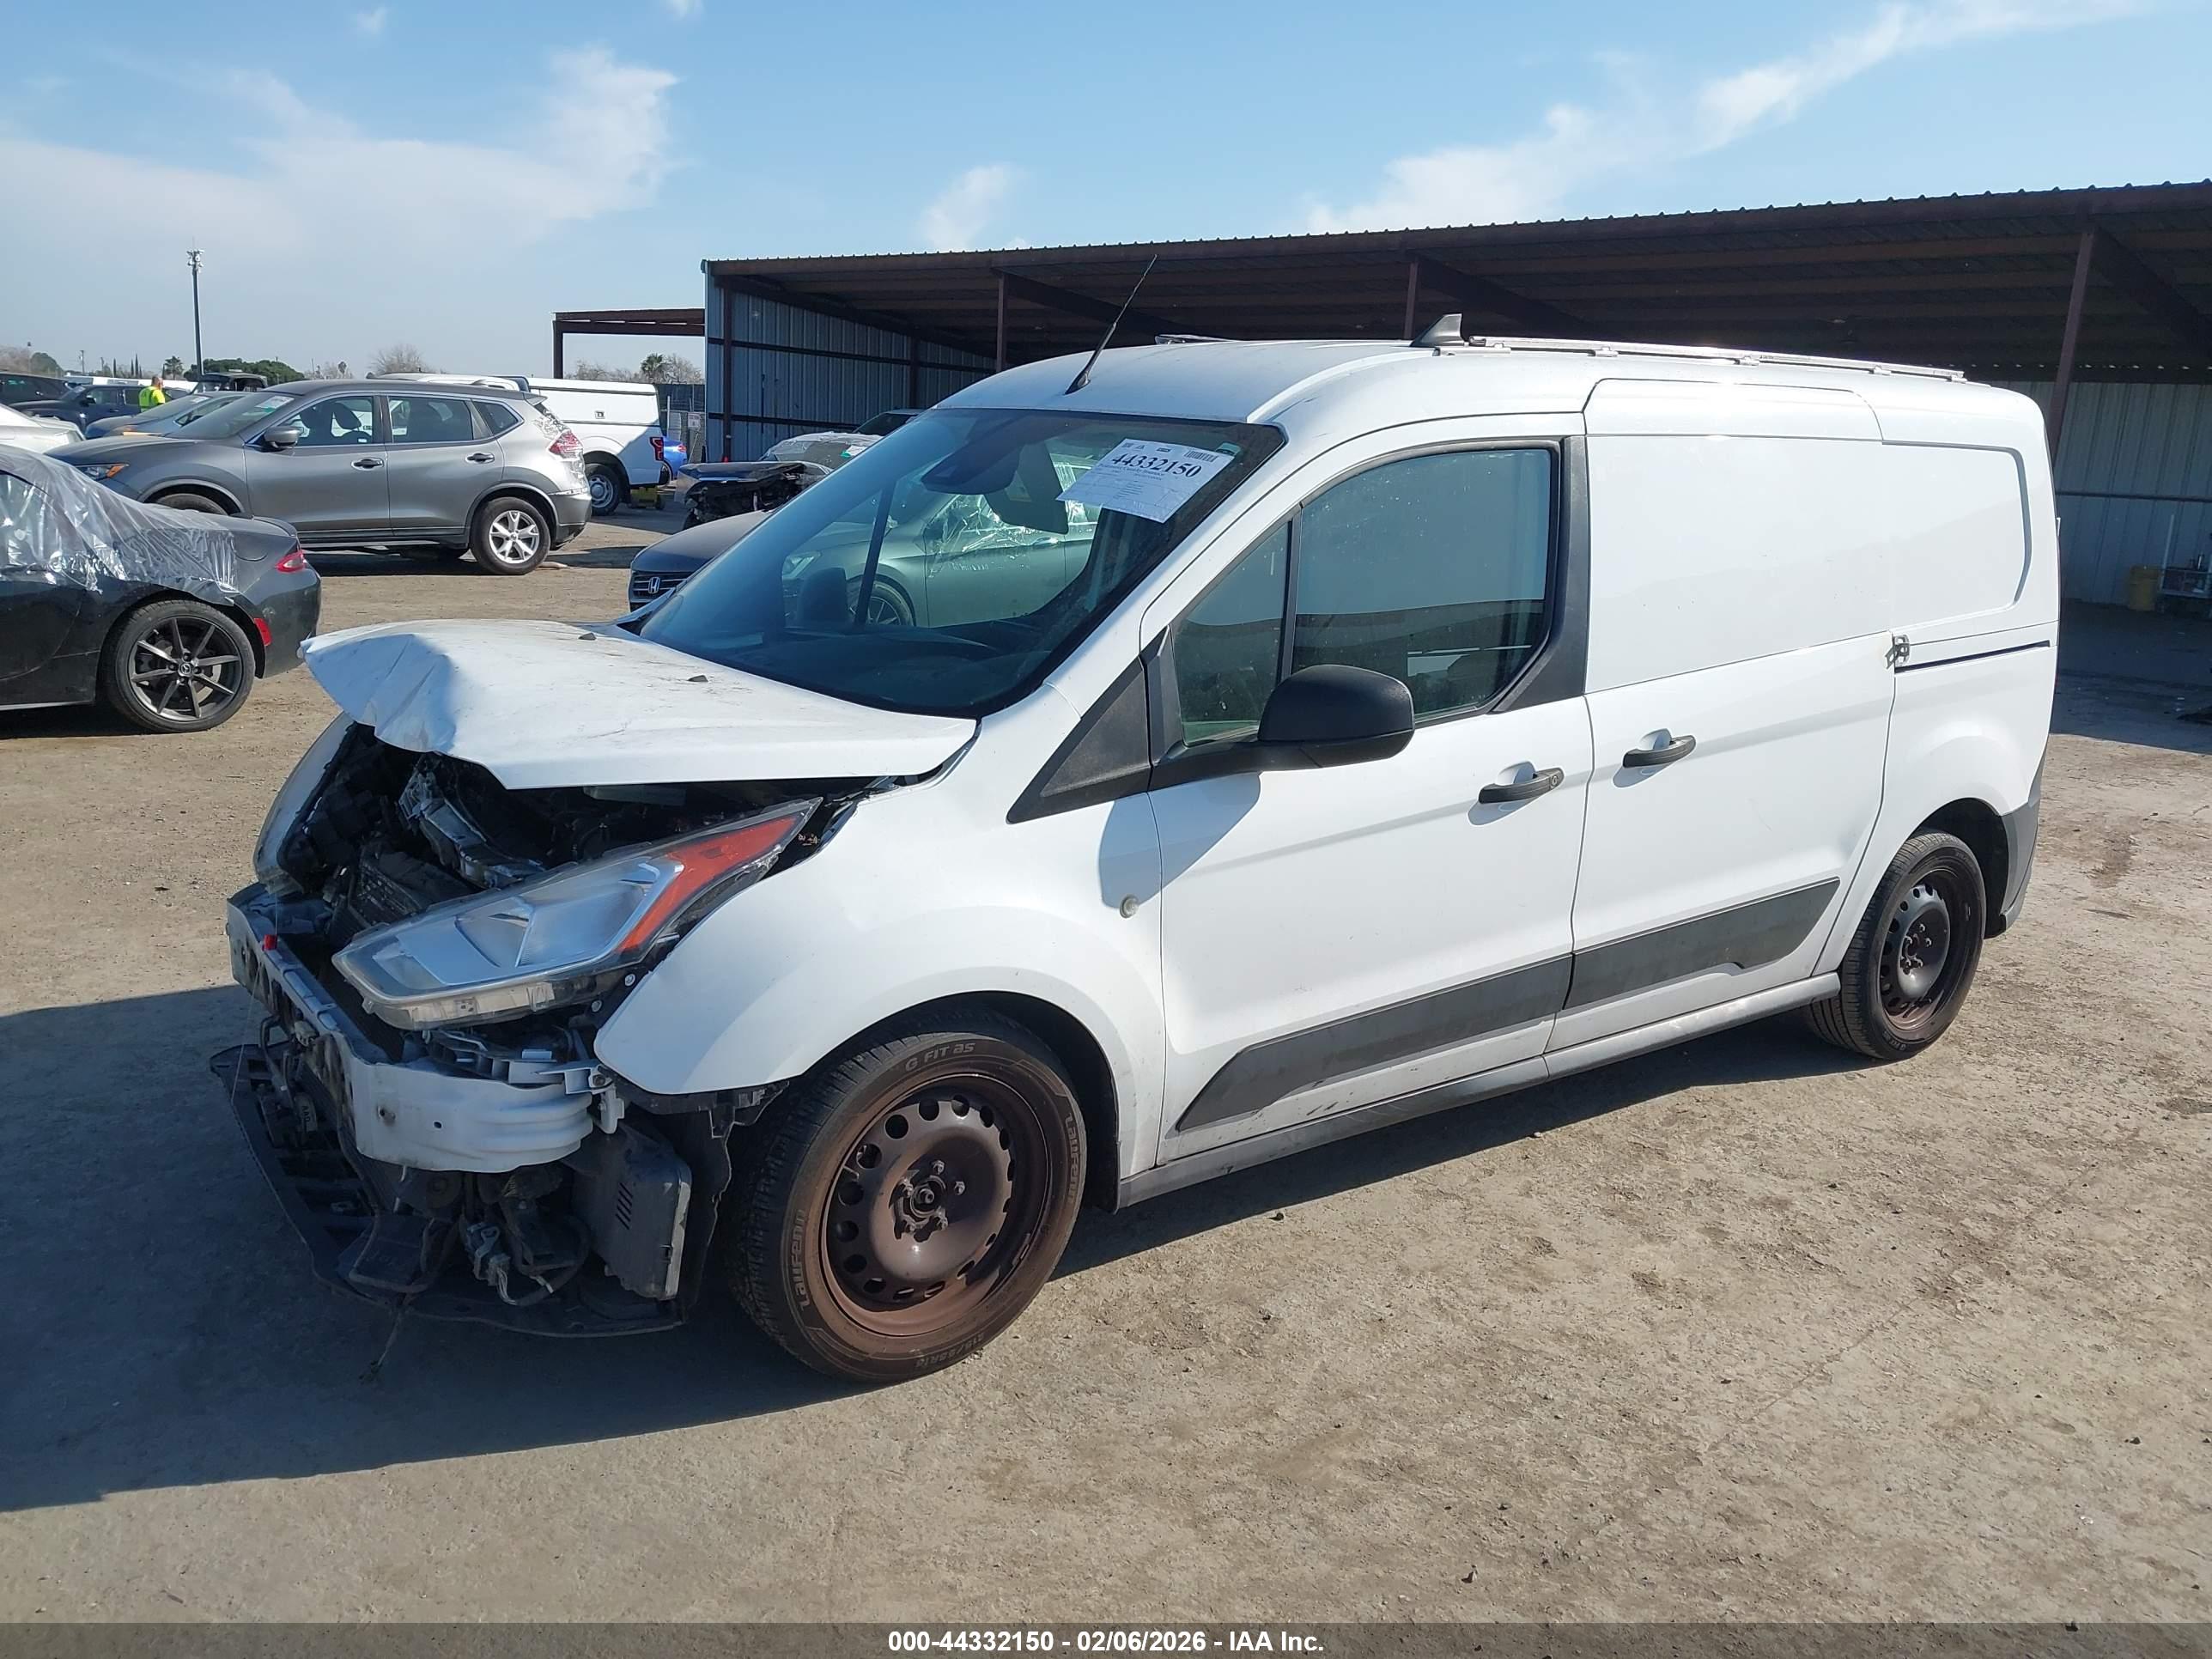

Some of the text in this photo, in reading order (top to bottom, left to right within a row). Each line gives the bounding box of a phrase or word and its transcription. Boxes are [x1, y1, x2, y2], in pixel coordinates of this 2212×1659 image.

[1112, 453, 1202, 477] 44332150
[905, 1057, 918, 1072] G
[924, 1046, 950, 1063] FIT
